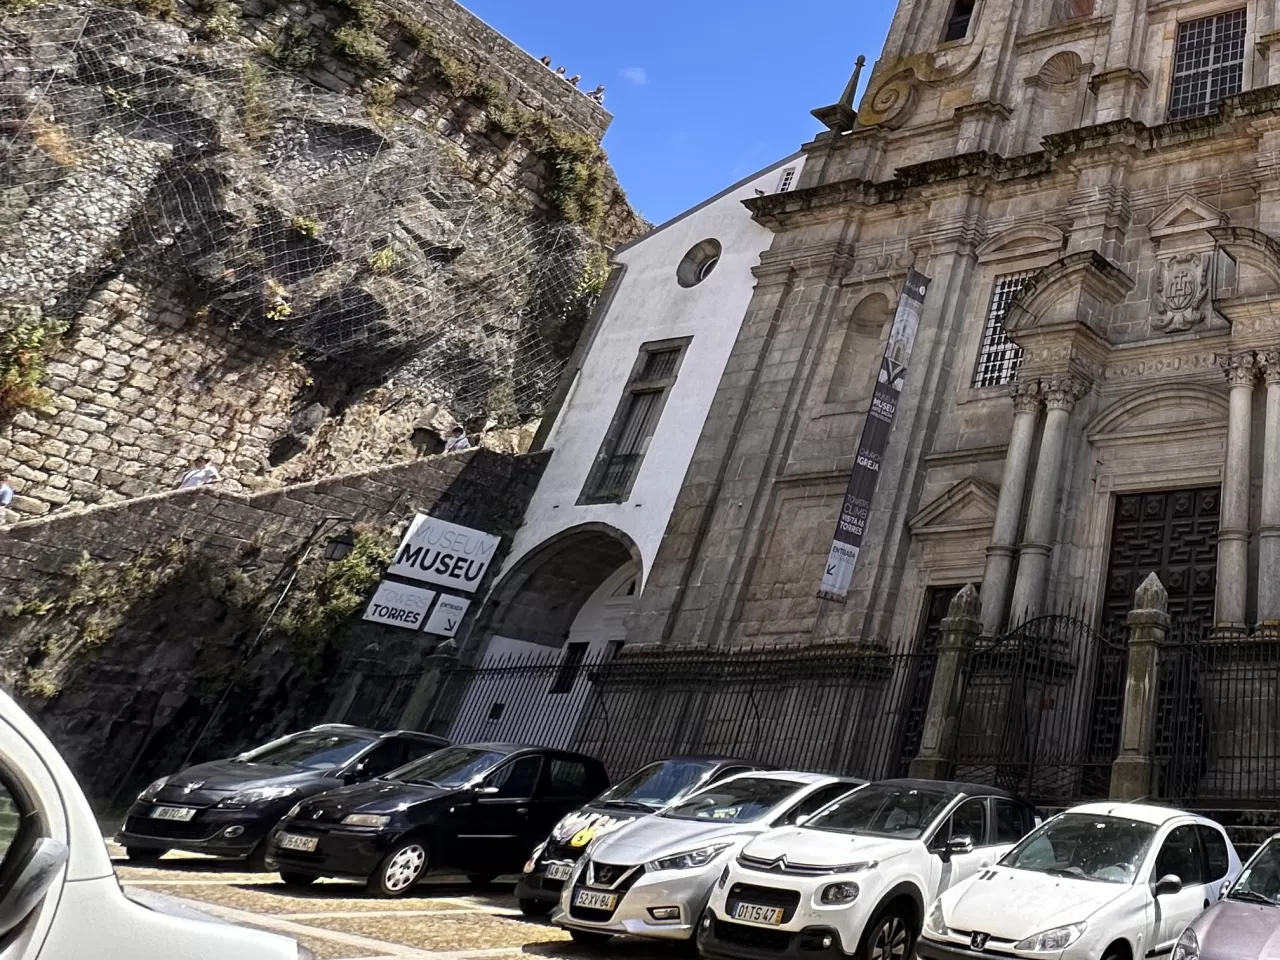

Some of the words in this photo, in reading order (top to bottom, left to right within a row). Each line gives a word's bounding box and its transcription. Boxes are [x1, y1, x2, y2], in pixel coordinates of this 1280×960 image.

[873, 398, 895, 413] MUSEU
[857, 455, 879, 472] IGREJA
[847, 494, 870, 508] TOWERS
[843, 503, 868, 519] CLIMB
[840, 520, 863, 536] TORRES
[415, 522, 495, 558] MUSEUM
[832, 545, 856, 558] ENTRADA
[397, 543, 485, 582] MUSEU
[381, 588, 429, 608] TOWERS
[440, 601, 463, 611] ENTRADA
[371, 603, 421, 624] TORRES
